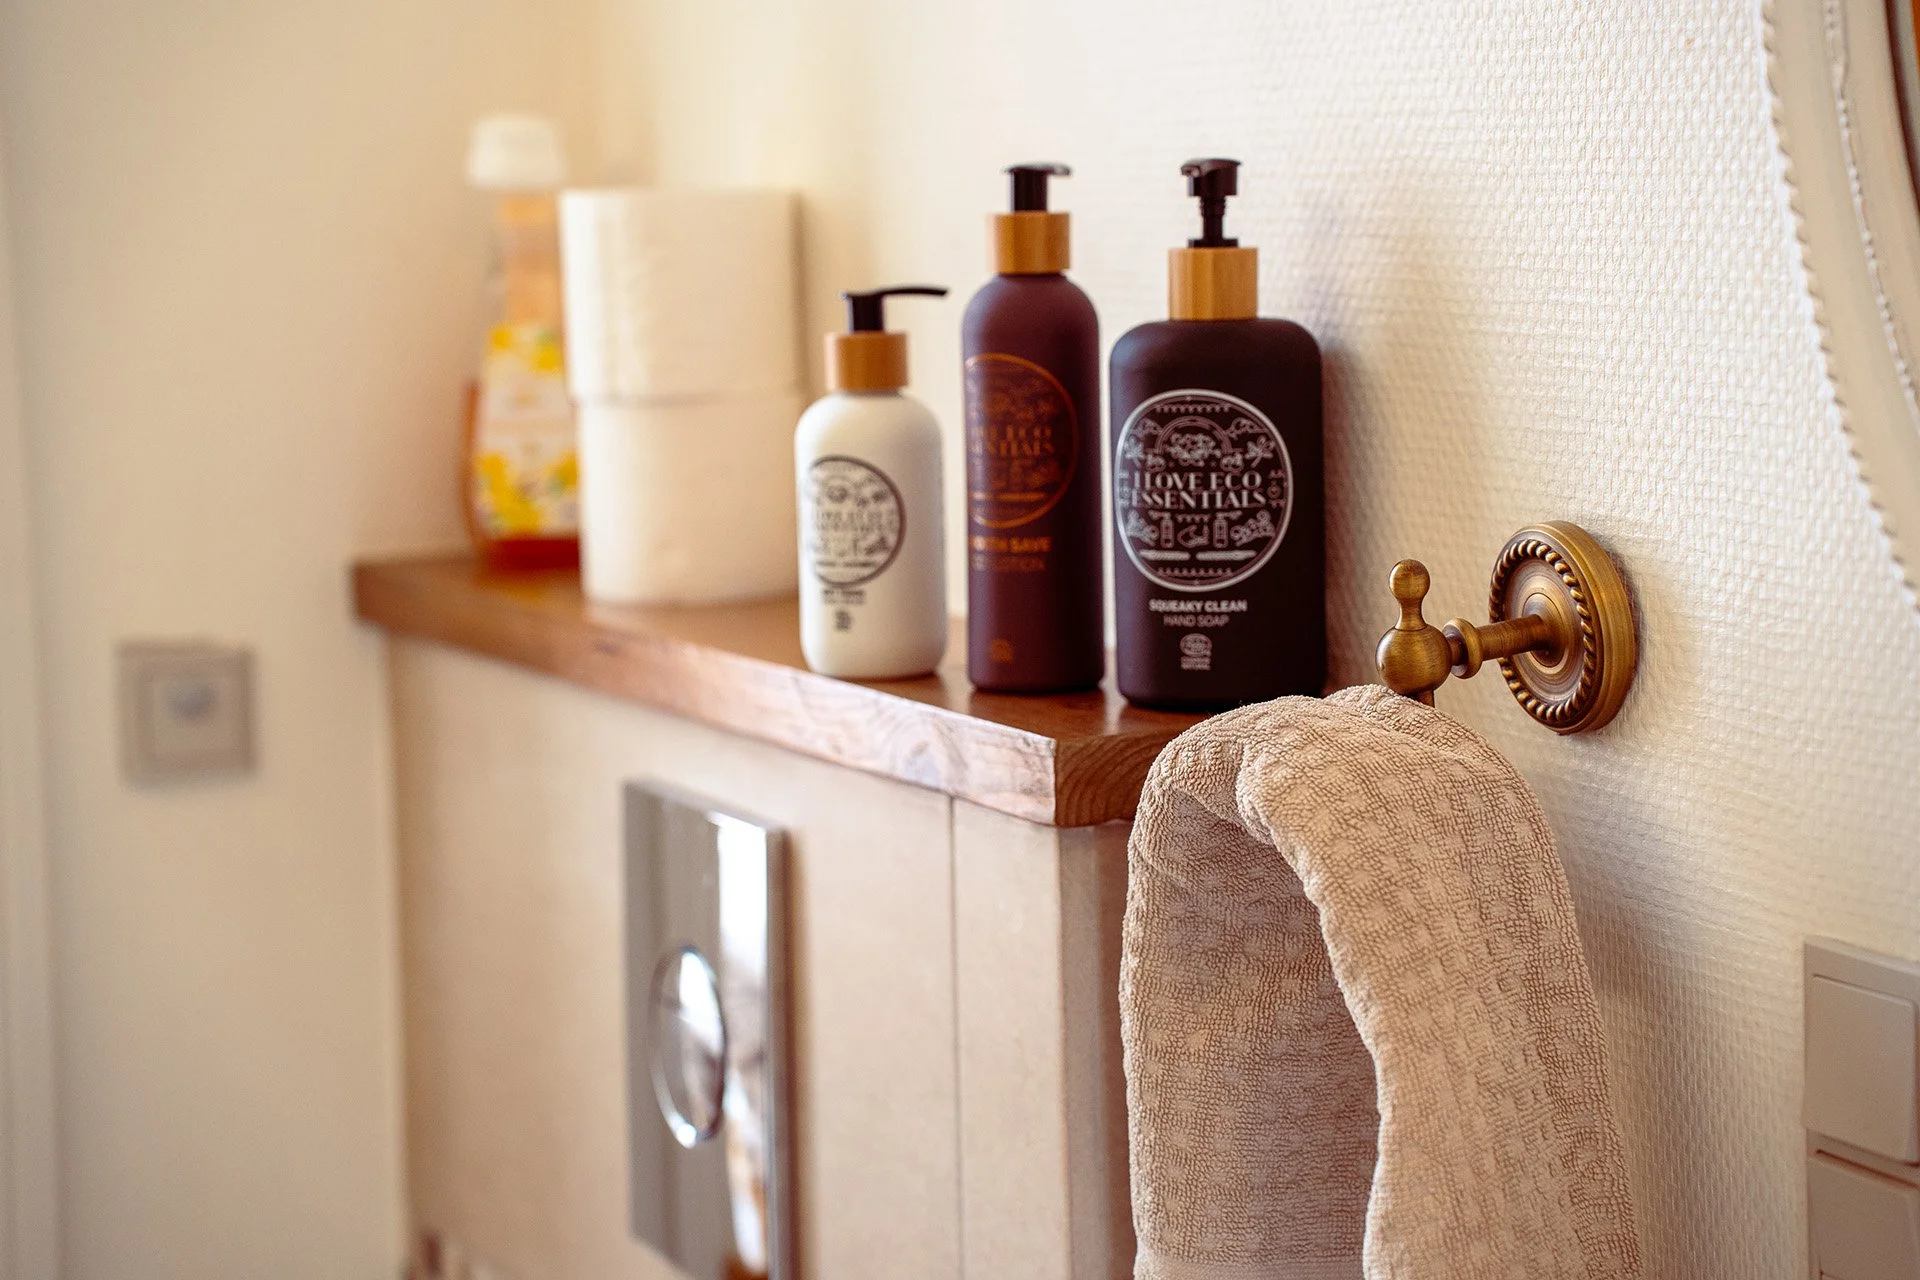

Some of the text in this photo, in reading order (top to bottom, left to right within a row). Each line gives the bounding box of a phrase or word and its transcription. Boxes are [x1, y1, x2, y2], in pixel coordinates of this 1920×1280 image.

[1209, 470, 1262, 490] ECO
[1131, 488, 1267, 509] ESSENTIALS
[1149, 599, 1248, 613] SQUEAKY CLEAN
[1163, 614, 1230, 627] HAND SOAP
